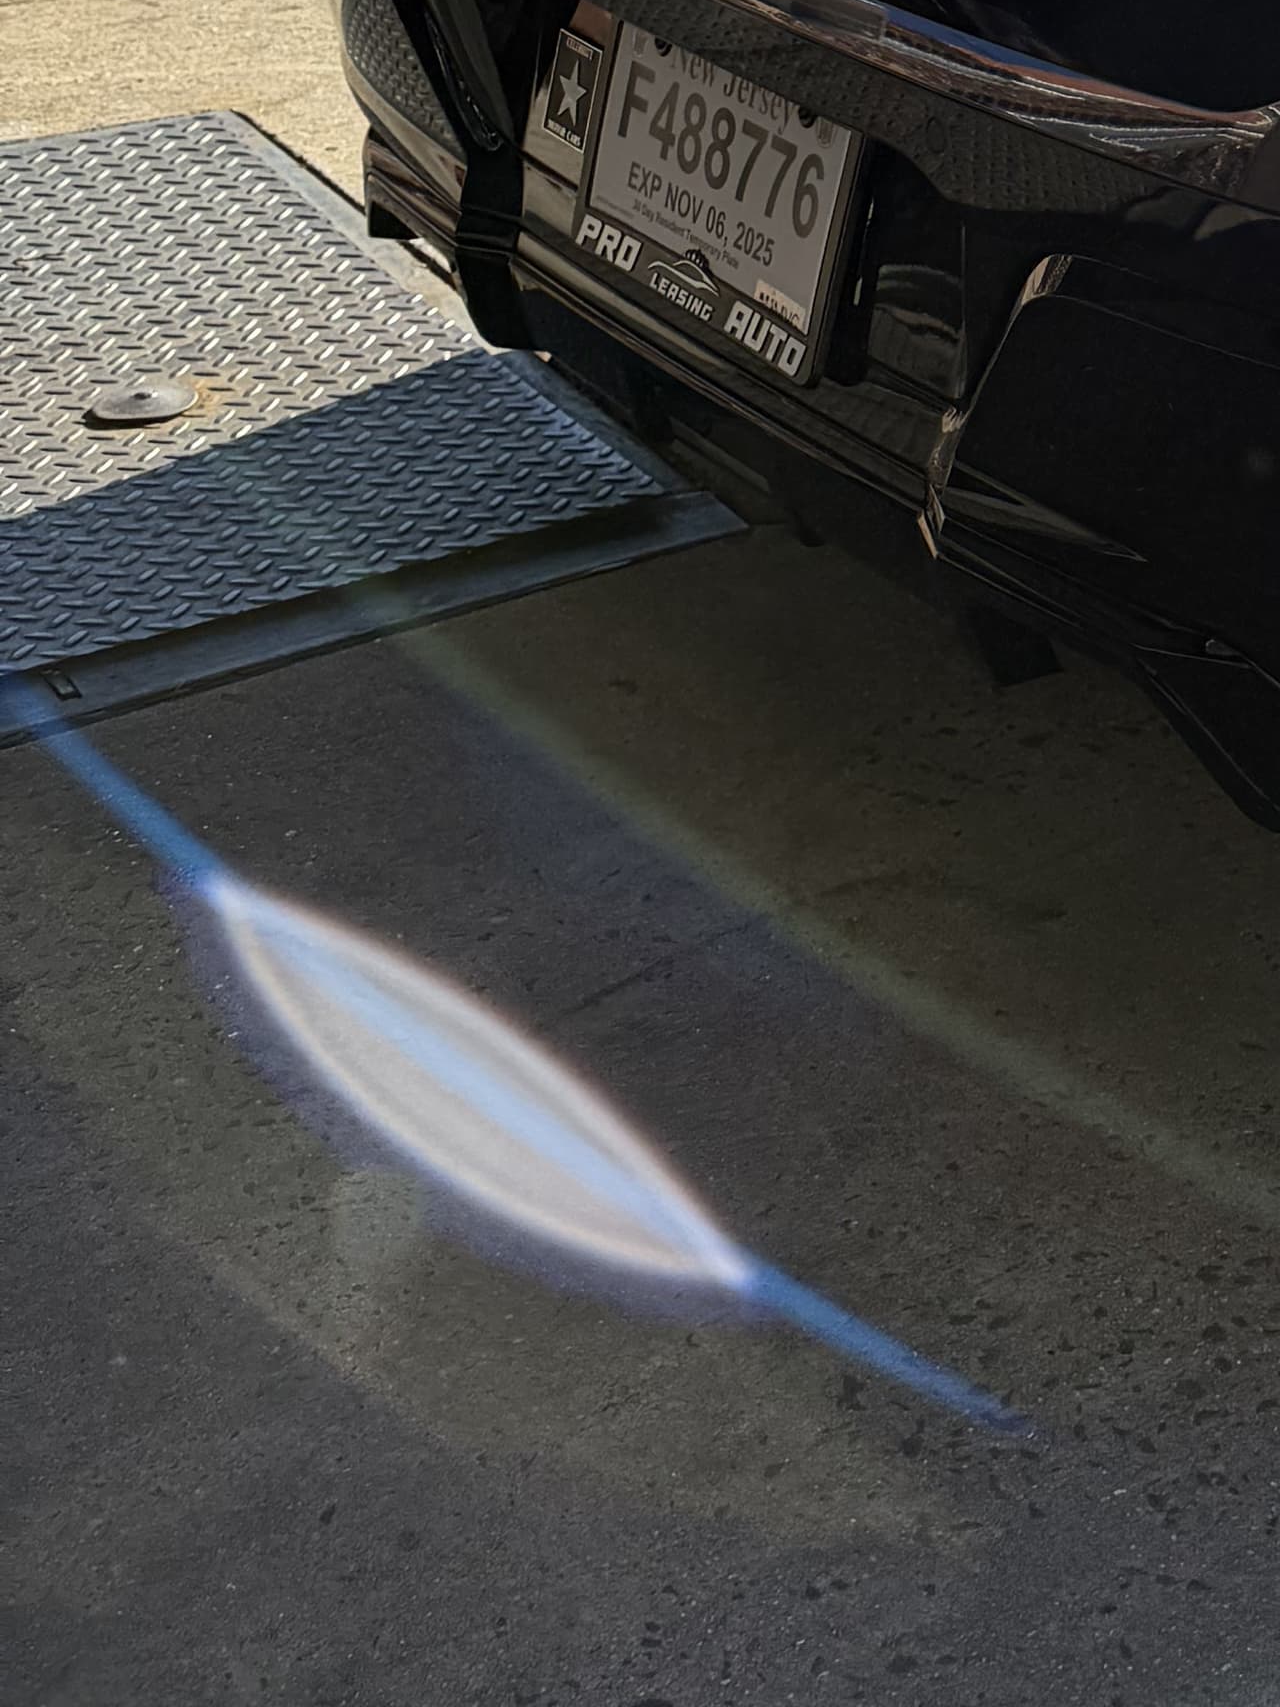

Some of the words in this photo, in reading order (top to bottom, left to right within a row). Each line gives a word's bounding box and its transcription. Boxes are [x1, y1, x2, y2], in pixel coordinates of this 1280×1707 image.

[617, 60, 825, 239] F488776
[723, 72, 793, 135] Jersey
[627, 160, 662, 197] EXP
[664, 181, 704, 224] NOV
[706, 205, 730, 248] 06,
[733, 221, 776, 268] 2025
[575, 213, 644, 272] PRO
[724, 300, 808, 378] AUTO
[649, 271, 715, 322] LEASING
